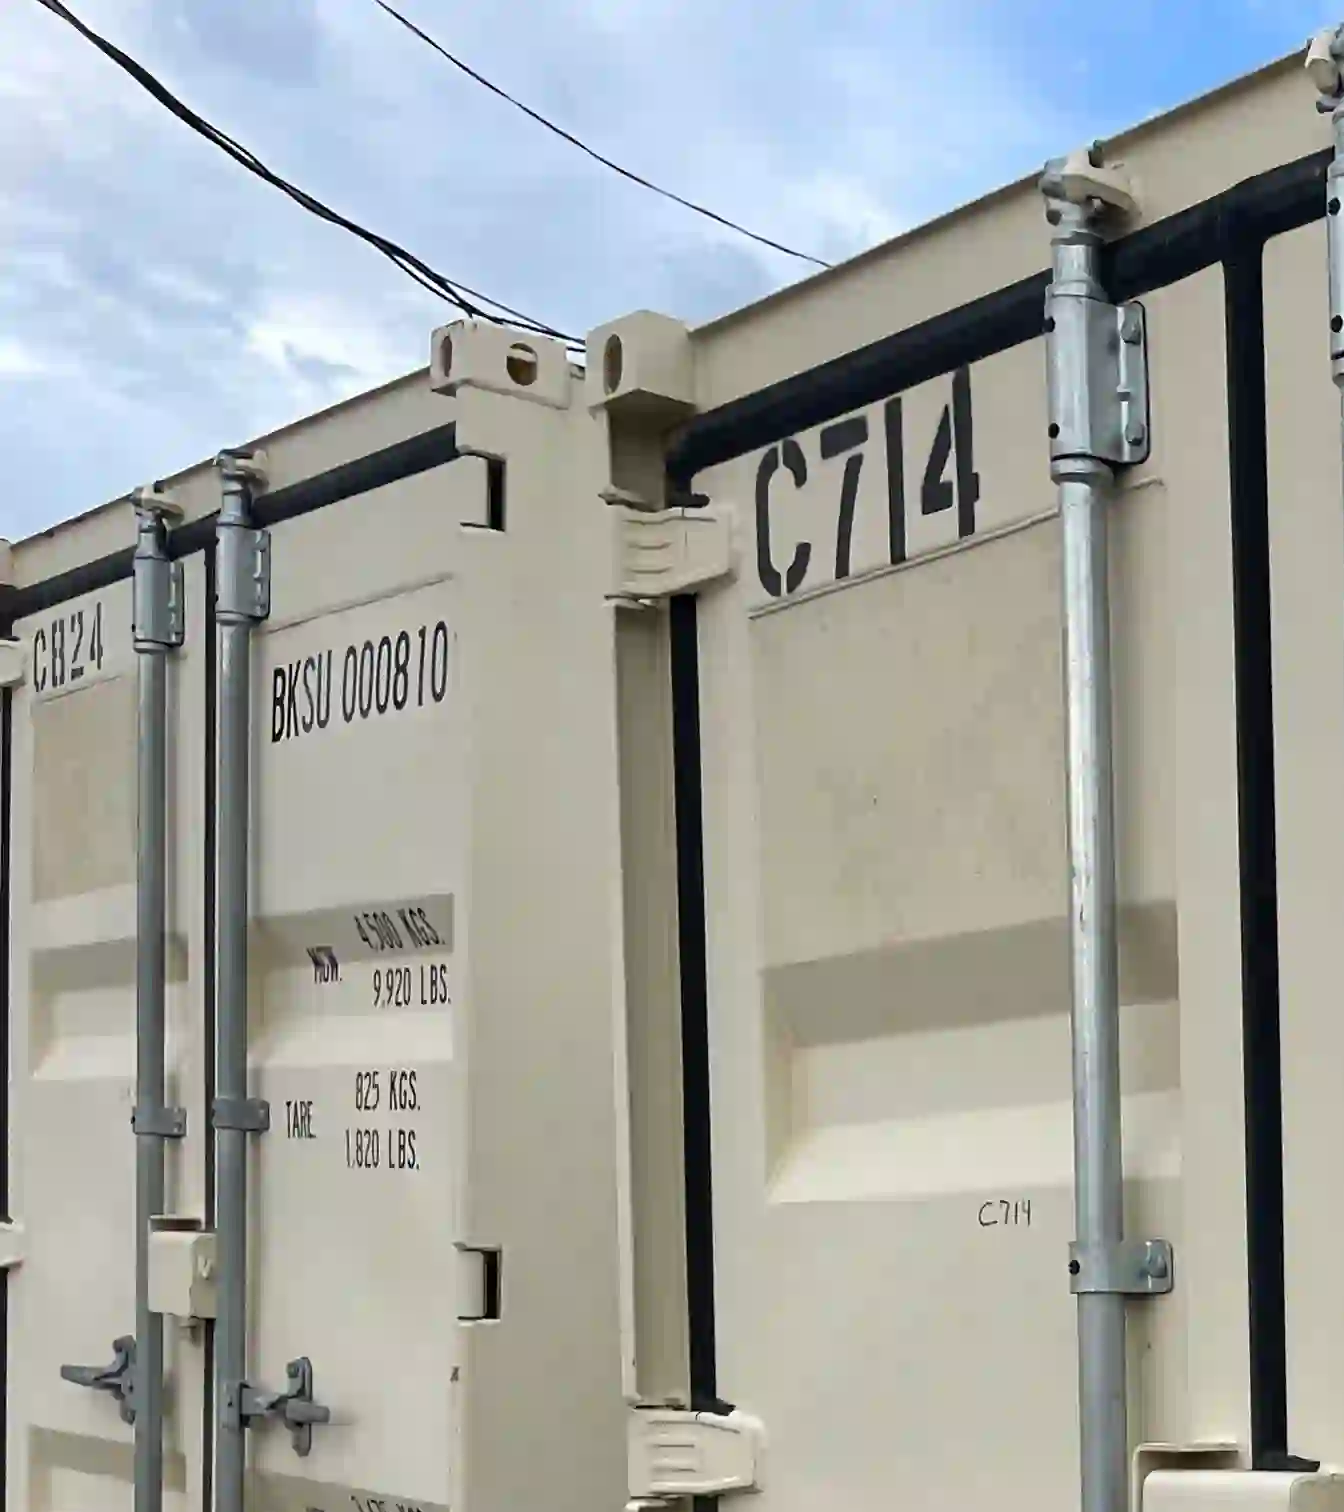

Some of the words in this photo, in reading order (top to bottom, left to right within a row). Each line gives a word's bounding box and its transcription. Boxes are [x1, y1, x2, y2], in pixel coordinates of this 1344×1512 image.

[755, 363, 980, 597] C714
[271, 650, 333, 743] BKSU
[342, 620, 448, 723] 000810
[355, 1070, 380, 1110] 825
[388, 1070, 421, 1111] KGS.
[388, 1129, 420, 1170] LBS.
[978, 1199, 1031, 1227] C714
